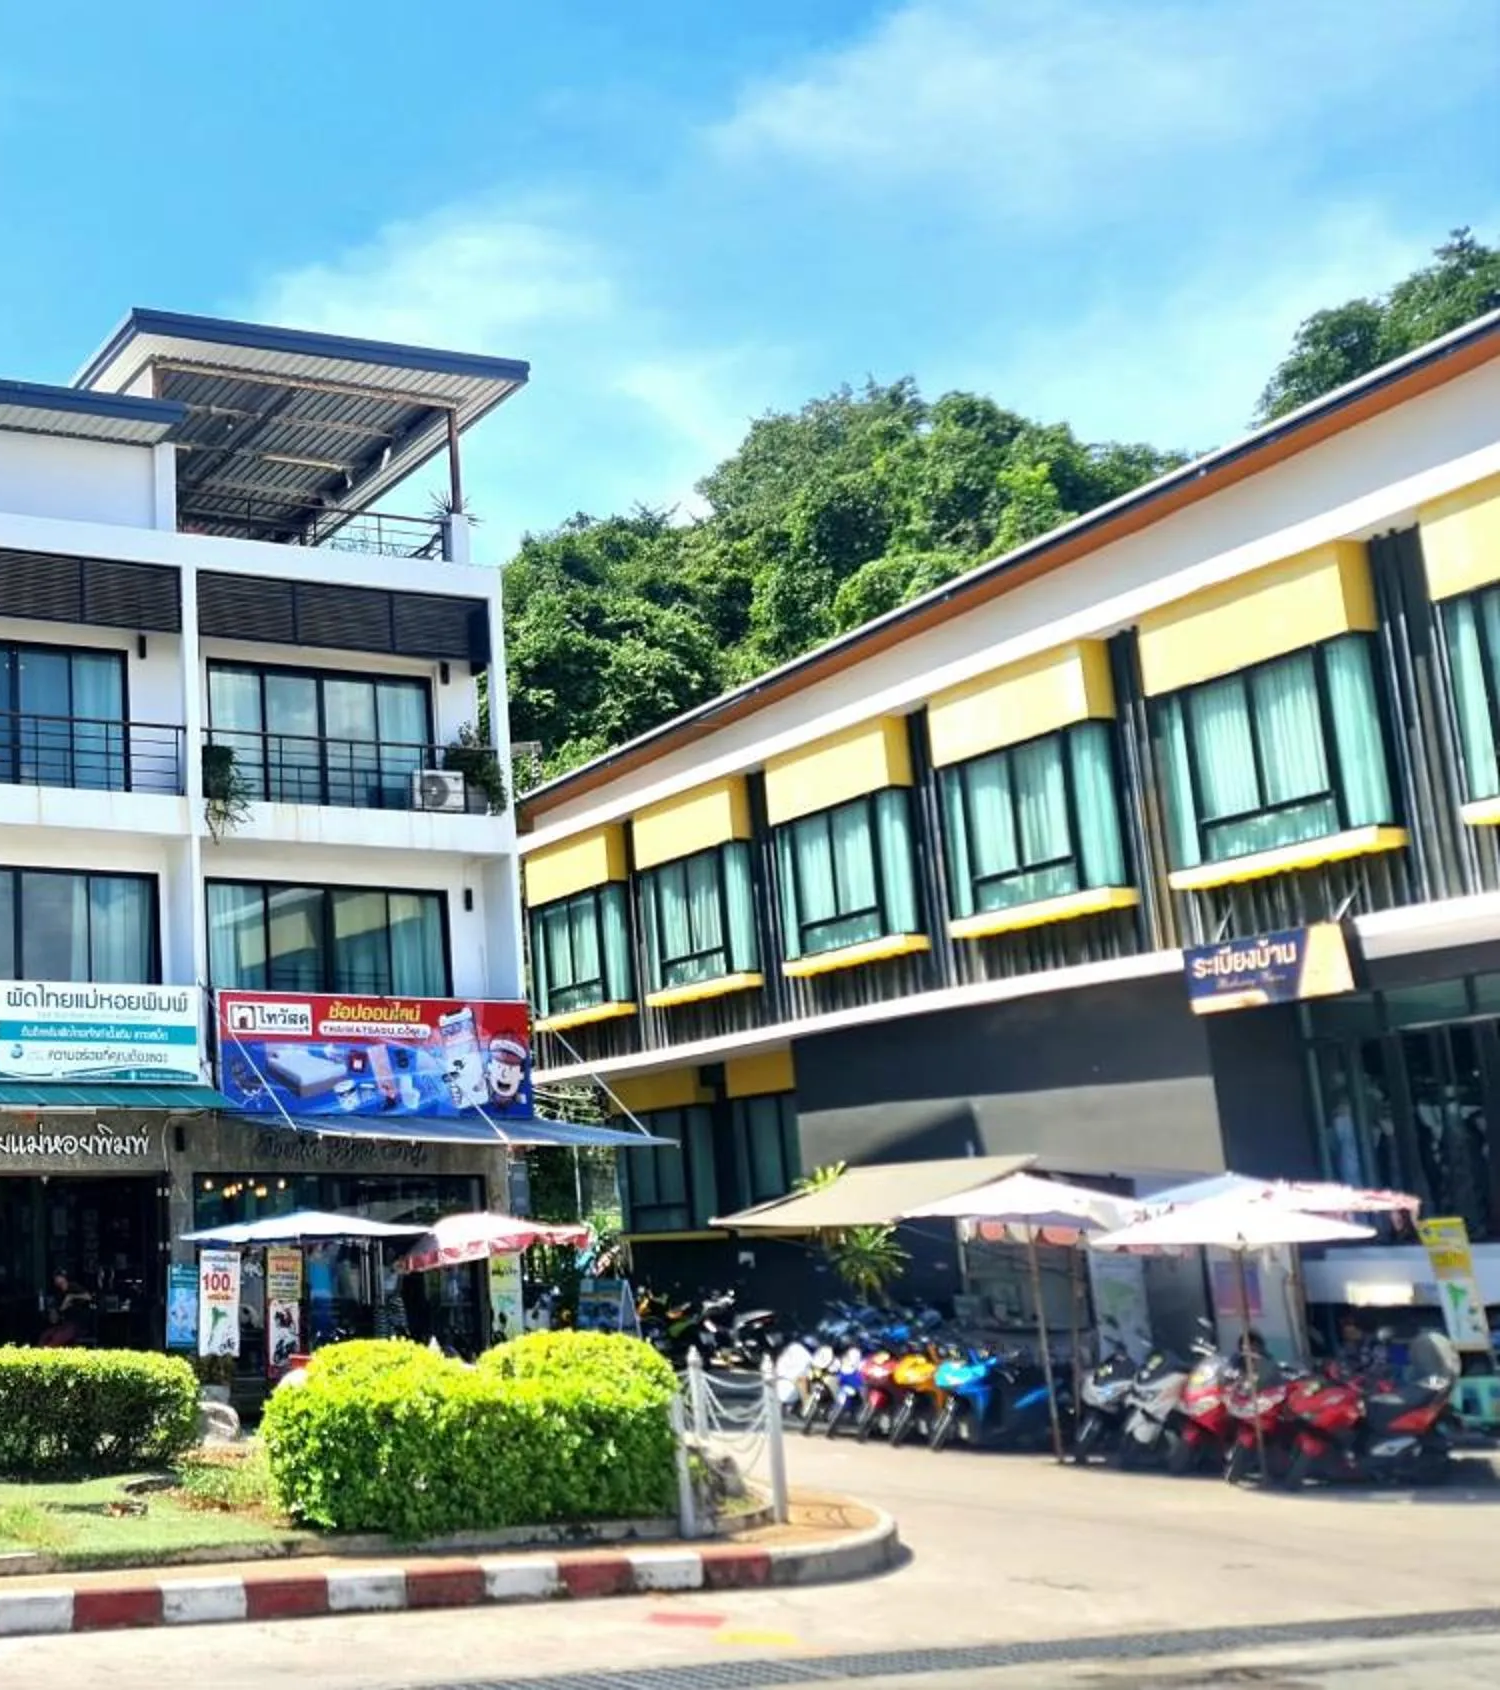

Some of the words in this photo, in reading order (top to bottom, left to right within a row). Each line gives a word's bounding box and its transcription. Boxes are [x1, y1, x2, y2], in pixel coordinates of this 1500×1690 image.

[1192, 939, 1297, 979] ระเบียงบ้าน
[257, 1006, 309, 1032] ไทวัสดุ
[202, 1273, 231, 1291] 100
